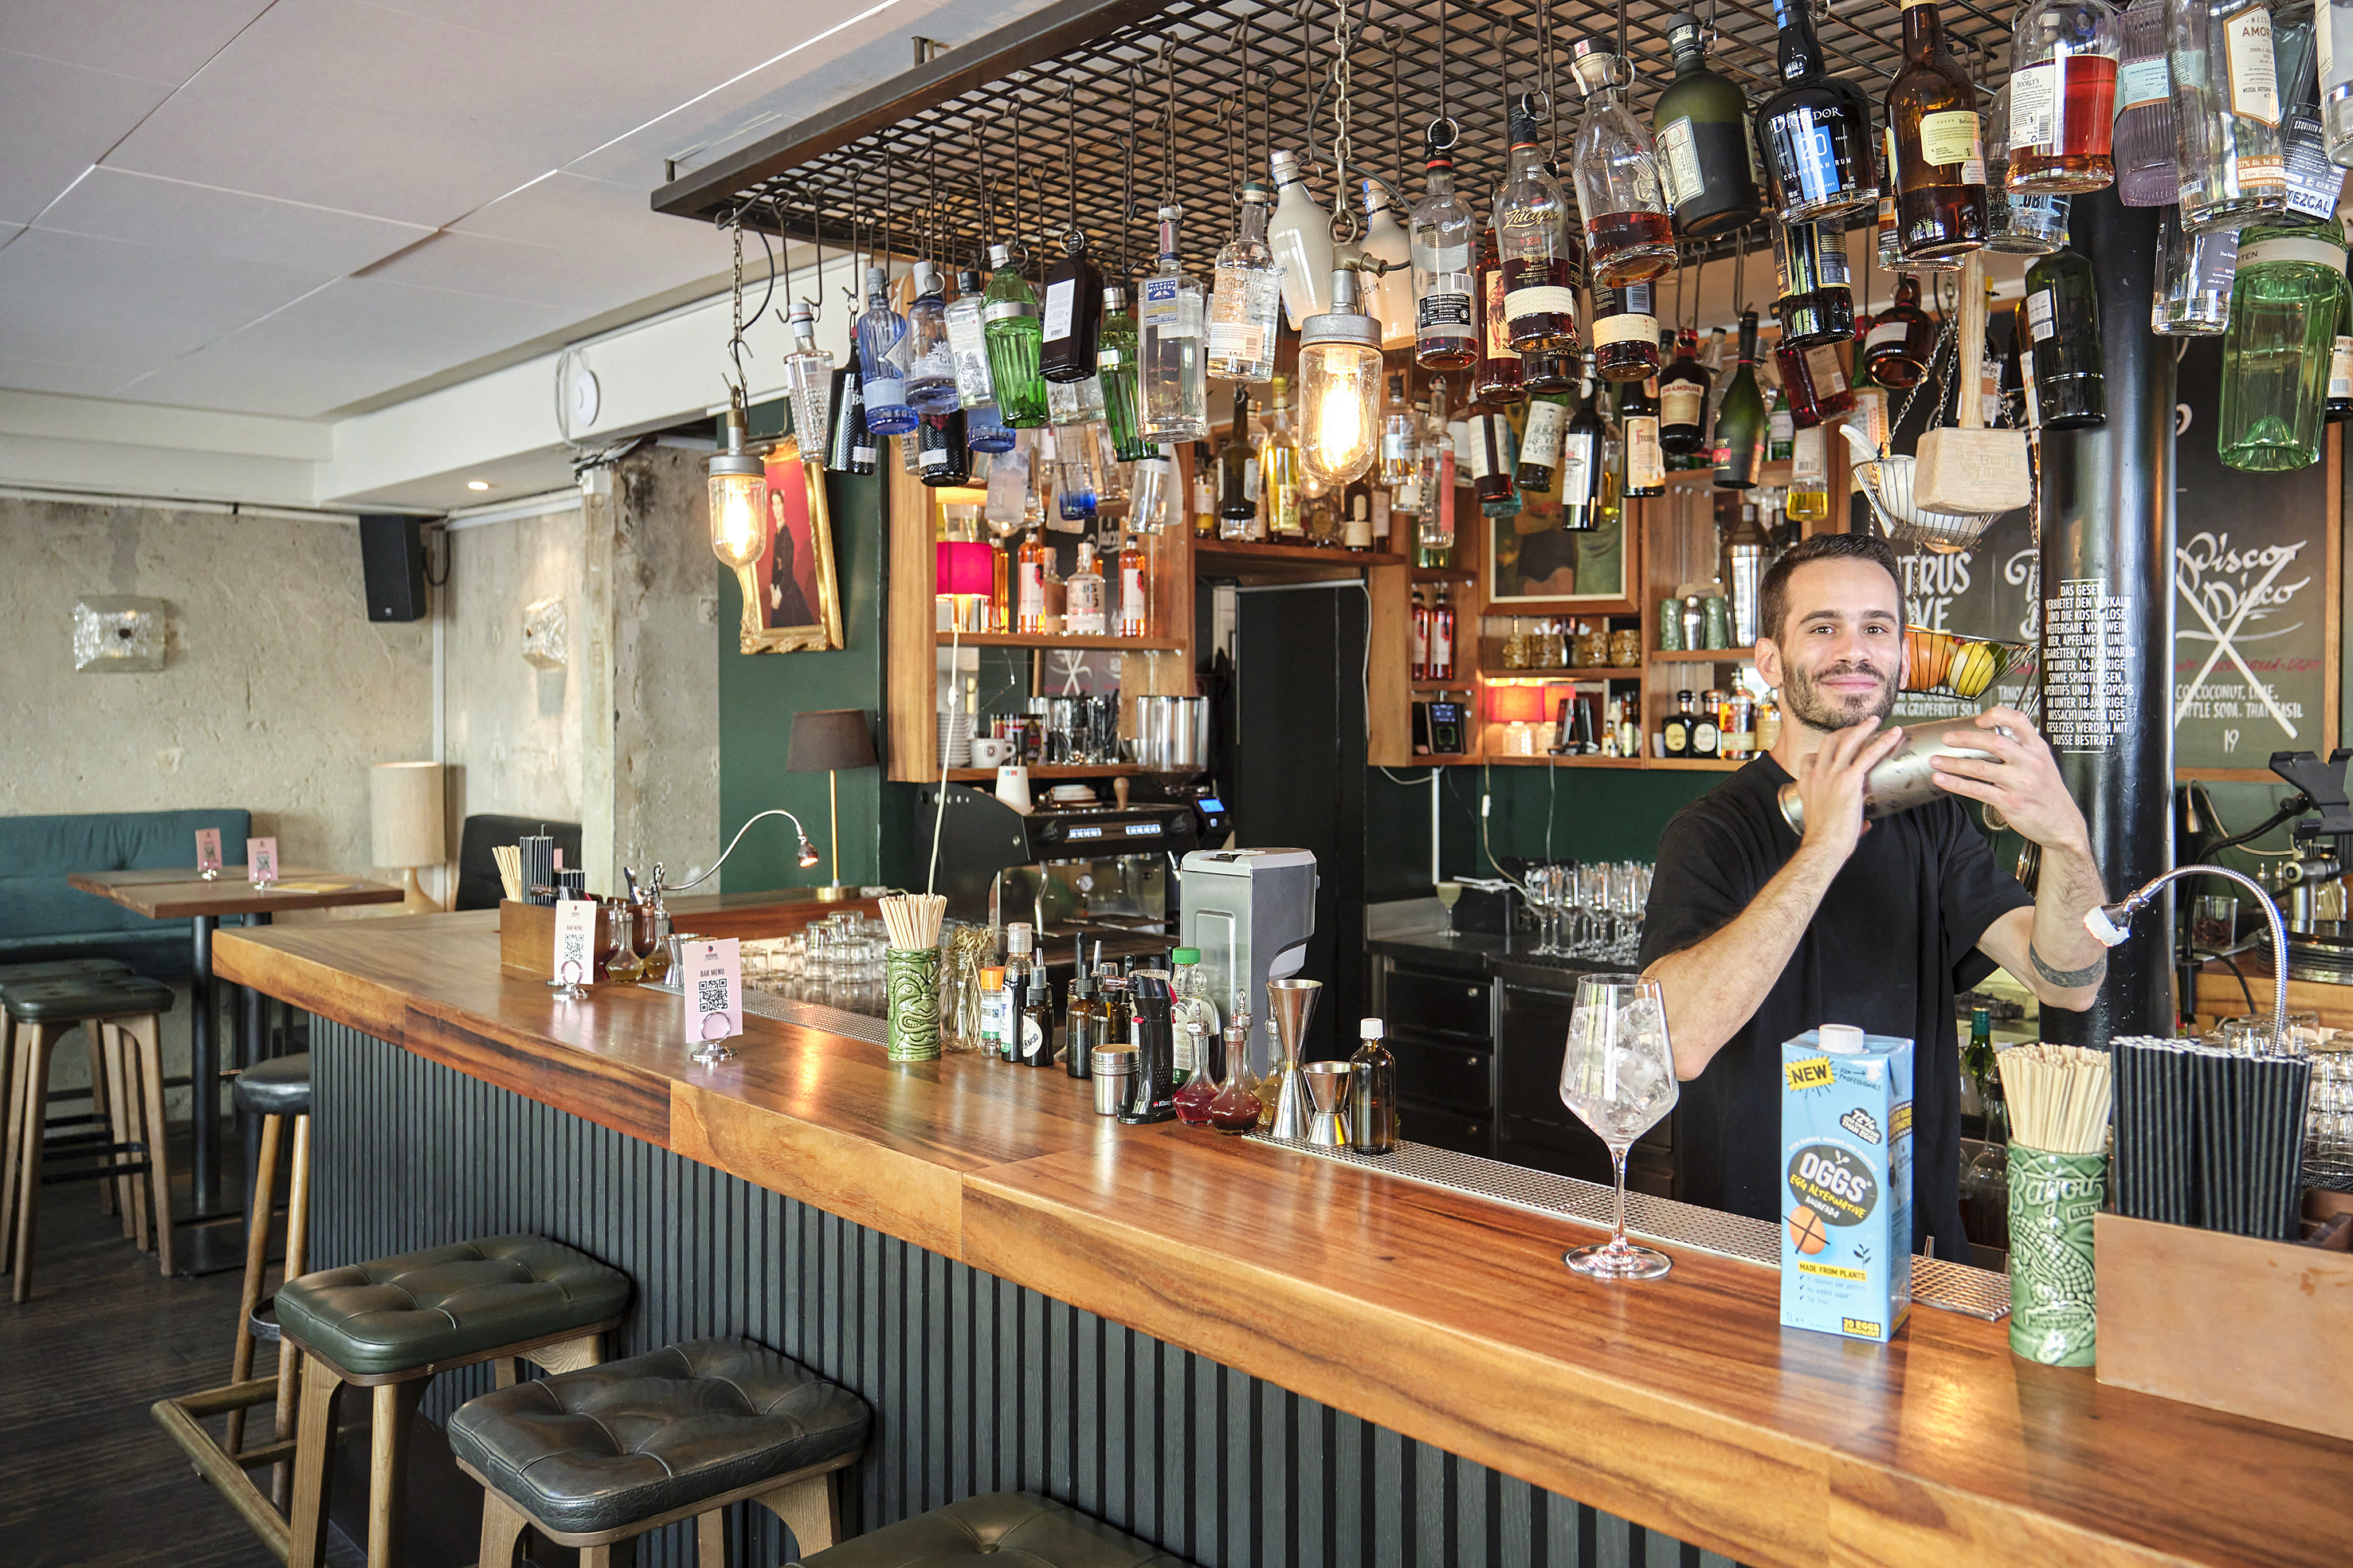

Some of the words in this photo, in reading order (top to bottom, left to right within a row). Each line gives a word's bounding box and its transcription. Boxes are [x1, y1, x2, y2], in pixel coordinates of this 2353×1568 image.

[1798, 133, 1828, 161] 20
[1783, 161, 1830, 181] COLOMBAN
[1834, 157, 1852, 167] RUM
[2285, 189, 2330, 214] MEZCAL
[1503, 209, 1560, 232] Zacapa
[1526, 236, 1542, 245] 23
[2241, 250, 2259, 262] TEN
[1662, 385, 1700, 394] DRAMBUIE
[2061, 585, 2075, 597] DAS
[2045, 598, 2074, 610] VERBIETET
[2075, 597, 2092, 608] DEN
[2093, 596, 2131, 608] VRKAUF
[2202, 571, 2311, 627] Dico
[2048, 610, 2060, 622] UND
[2061, 610, 2073, 621] DIE
[2074, 609, 2127, 621] KOSTENLOSE
[2045, 622, 2084, 634] WEITERGABE
[2105, 621, 2130, 636] WEIN,
[2047, 635, 2062, 648] BIER,
[2062, 634, 2104, 646] APFELWEIN
[2108, 633, 2127, 645] UND
[2046, 661, 2054, 672] AN
[2054, 660, 2077, 672] UNTER
[2078, 657, 2128, 672] 16-JÄRIGE,
[2049, 672, 2068, 684] SOWIE
[2069, 672, 2124, 684] SPIRITUOSEN,
[2044, 684, 2070, 696] APERITIFS
[2072, 684, 2089, 696] UND
[2091, 684, 2134, 696] ALCOPOPS
[2046, 697, 2054, 708] AN
[2054, 696, 2077, 708] UNTER
[1907, 702, 1959, 717] GRAPEFRUIT
[2047, 709, 2108, 721] MISSACHTUNGEN
[2108, 709, 2126, 720] DES
[2046, 722, 2075, 733] GESETZES
[2075, 722, 2112, 733] WERDEN
[2112, 722, 2129, 733] MIT
[2053, 734, 2073, 746] BUSSE
[2074, 734, 2116, 747] BESTRAFT.
[2223, 728, 2240, 753] 19
[711, 967, 725, 977] MENU
[1791, 1064, 1827, 1084] NEW
[1838, 1073, 1881, 1092] PROFESSIONALS
[1852, 1109, 1876, 1131] 72%
[1841, 1120, 1859, 1135] THAN
[1858, 1128, 1879, 1145] EGGS
[1788, 1141, 1801, 1152] FOR
[1799, 1152, 1867, 1202] OGGS
[1789, 1173, 1808, 1191] EGG
[1808, 1183, 1866, 1219] ALTERNATIVE
[1804, 1194, 1840, 1219] AQUAFABA
[1799, 1263, 1818, 1273] MADE
[1819, 1267, 1838, 1276] FROM
[1839, 1269, 1866, 1280] PLANTS
[1816, 1288, 1833, 1297] added
[1846, 1283, 1866, 1292] portion
[1843, 1318, 1854, 1328] 20
[1855, 1320, 1880, 1332] EGGS
[1843, 1326, 1880, 1339] EQUIVALENT
